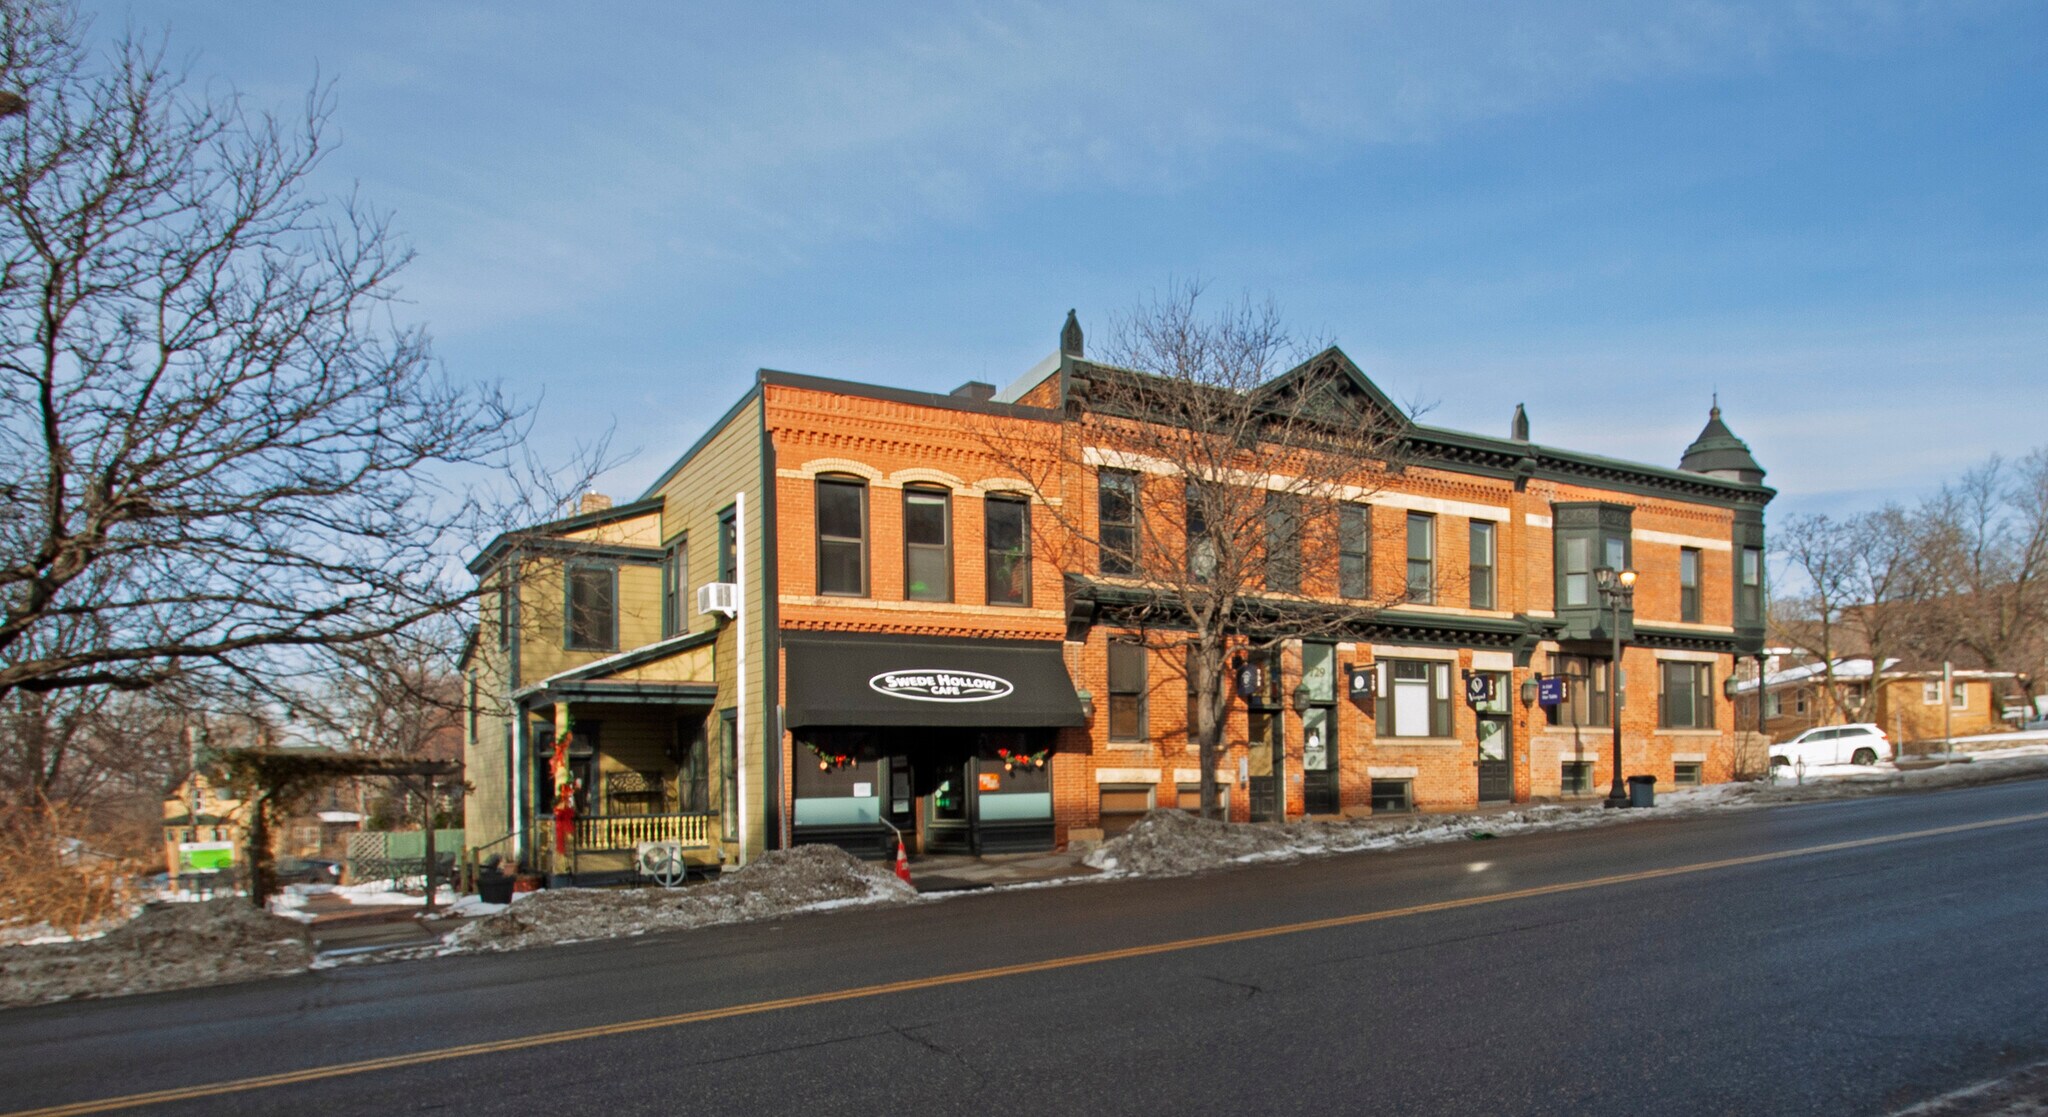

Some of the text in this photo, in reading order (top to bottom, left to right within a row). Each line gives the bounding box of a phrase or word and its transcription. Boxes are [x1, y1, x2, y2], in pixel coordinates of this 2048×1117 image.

[885, 674, 996, 689] SWEDE HOLLOW
[930, 686, 961, 695] CAFE
